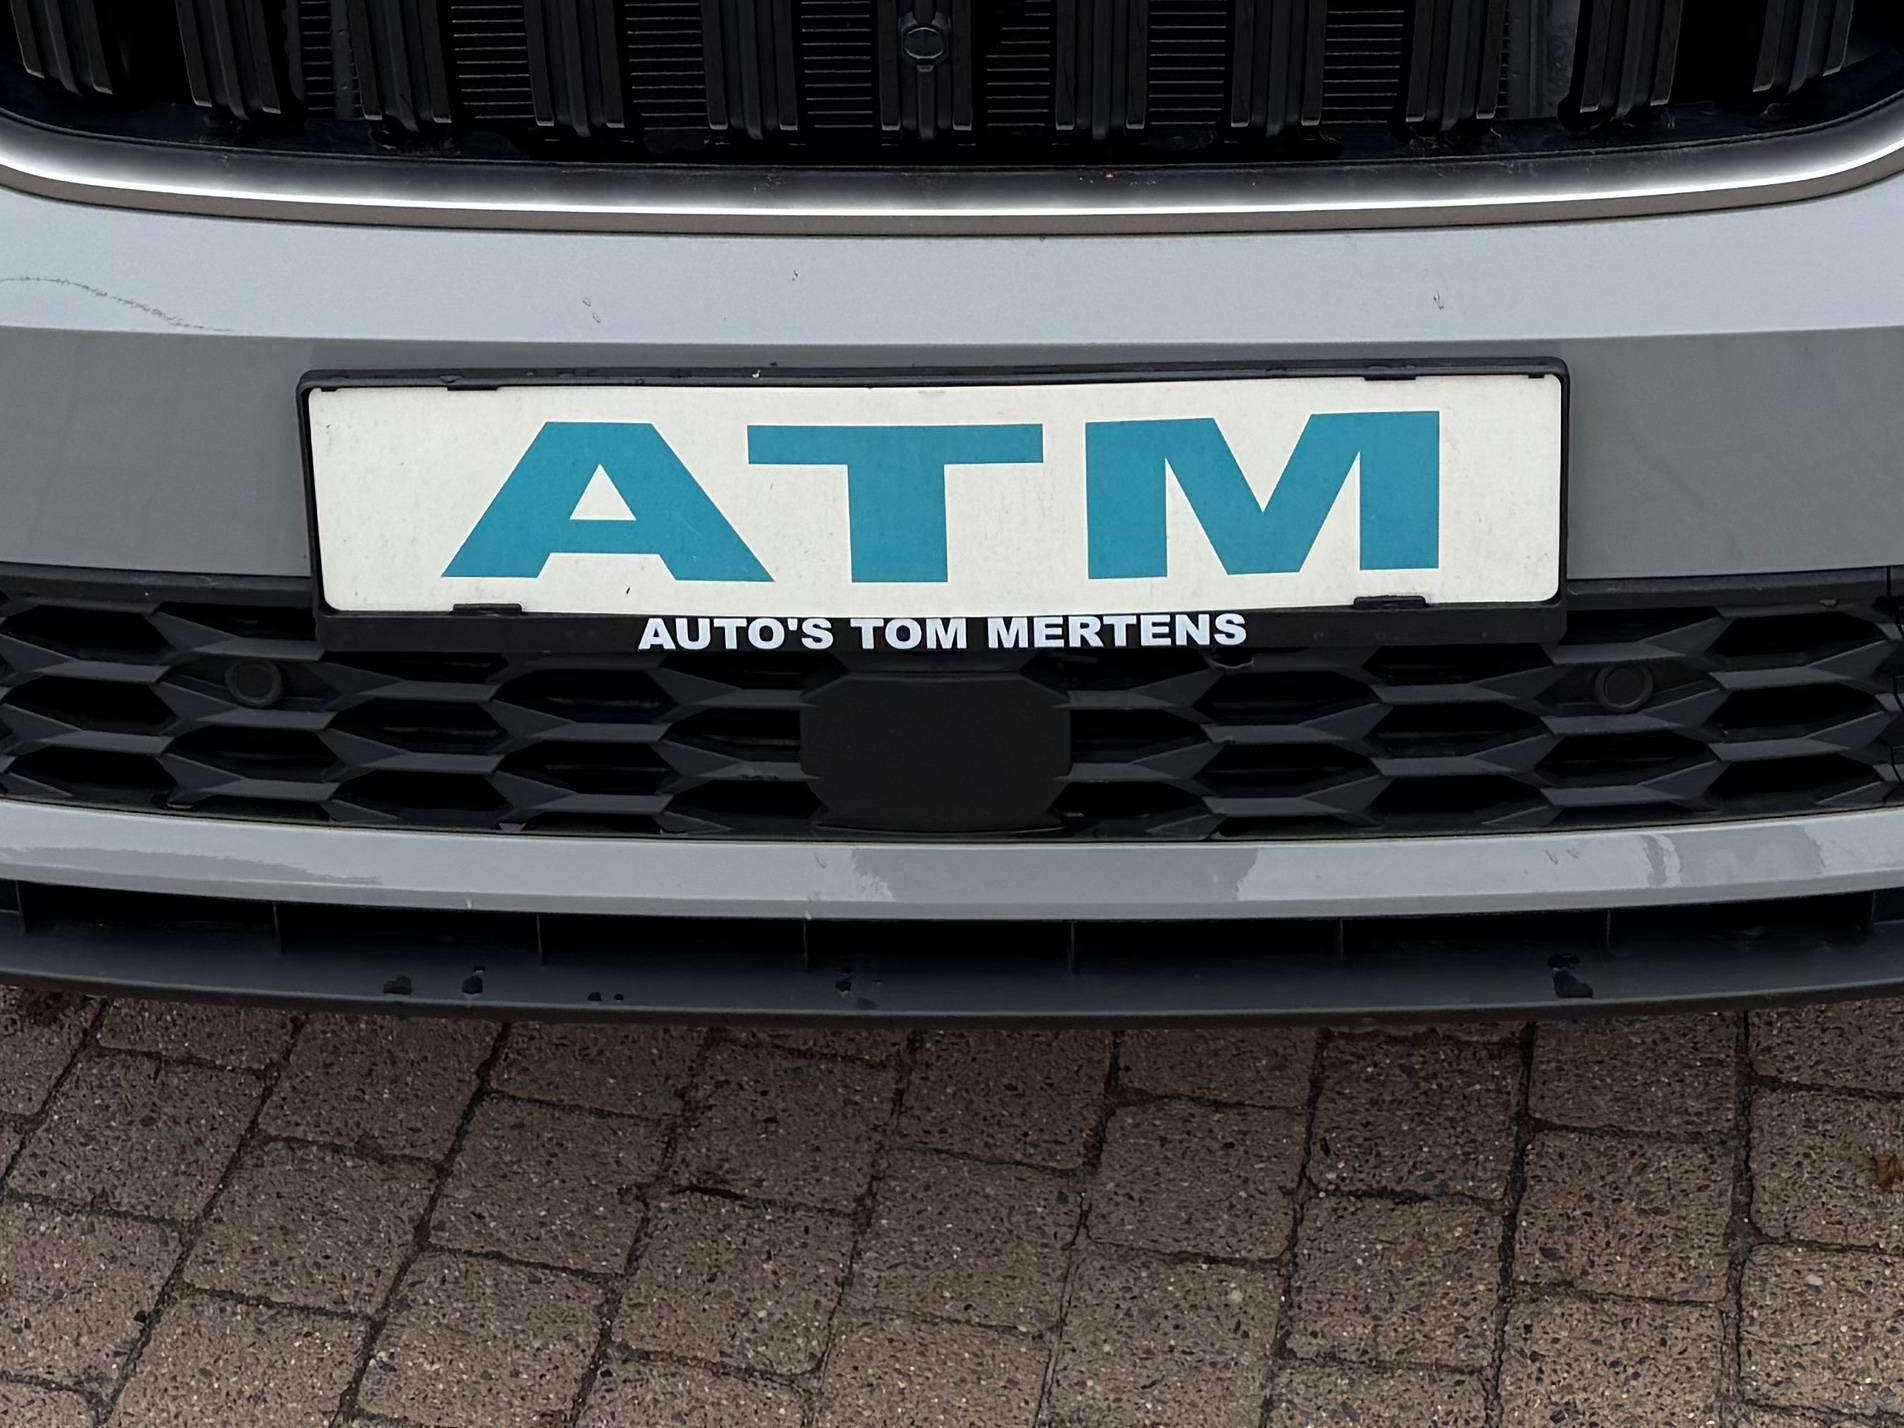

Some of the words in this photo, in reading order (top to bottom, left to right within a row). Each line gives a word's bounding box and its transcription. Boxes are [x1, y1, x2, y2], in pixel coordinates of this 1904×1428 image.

[440, 408, 1441, 584] ATM
[638, 617, 834, 650] AUTO'S
[850, 618, 967, 649] TOM
[986, 613, 1248, 649] MERTENS
